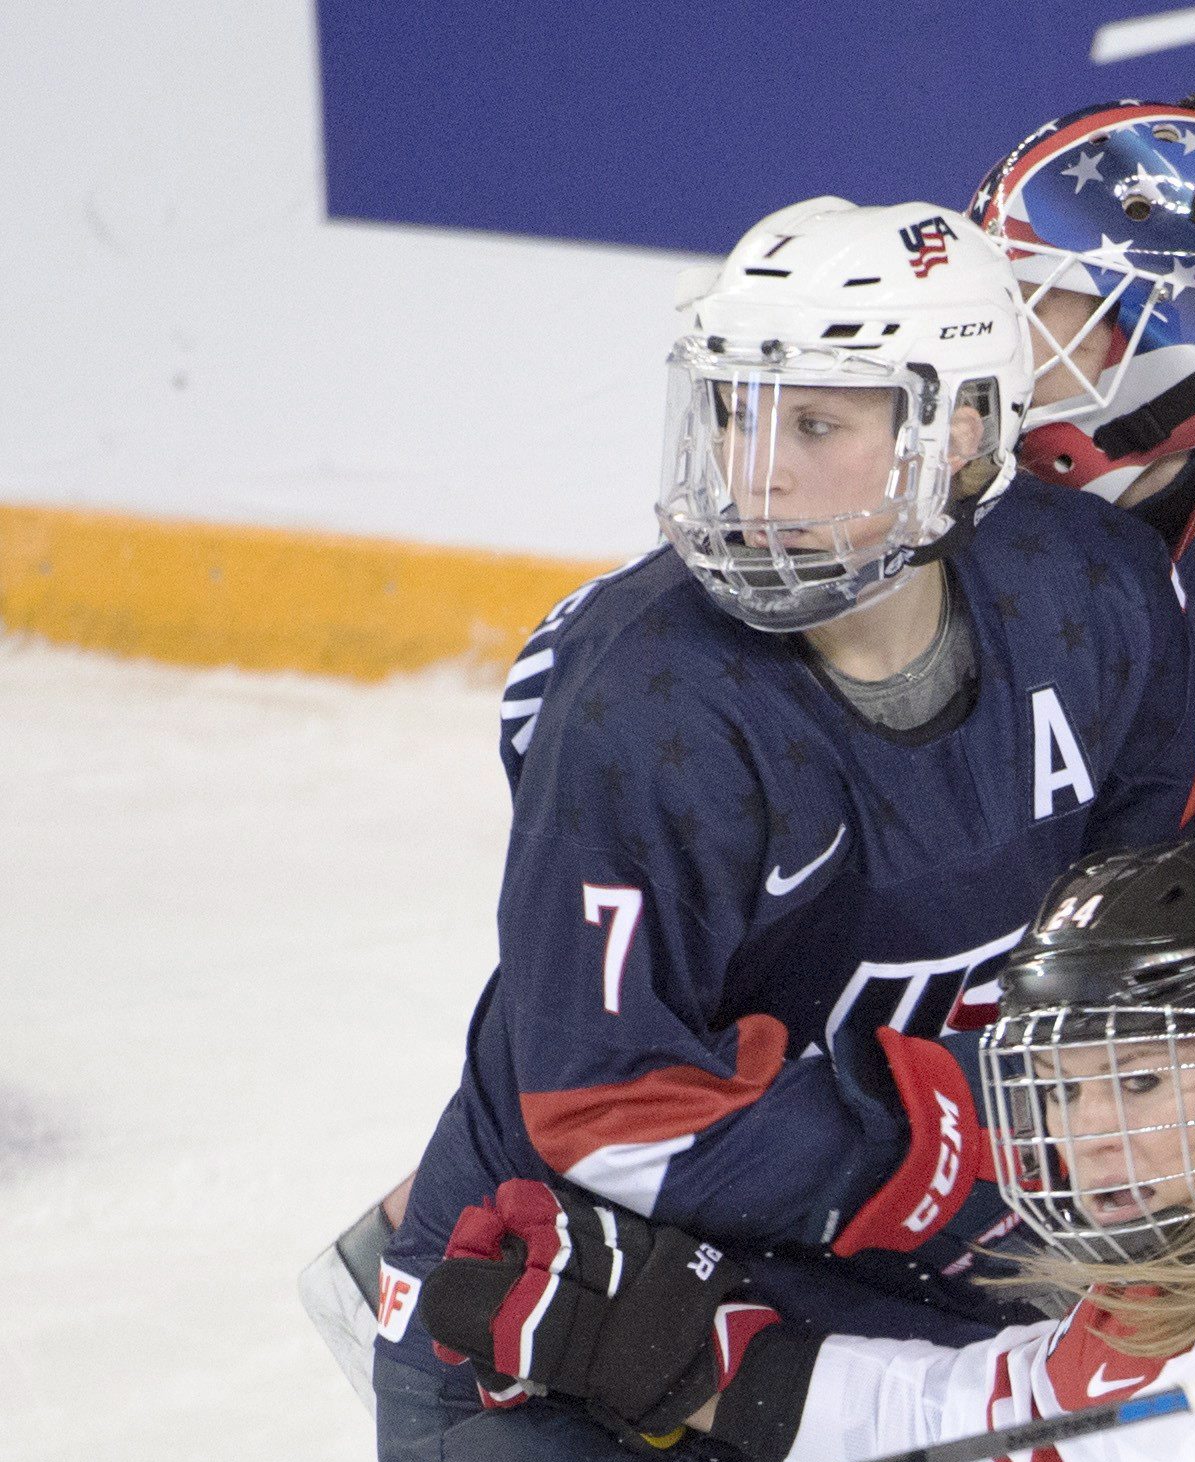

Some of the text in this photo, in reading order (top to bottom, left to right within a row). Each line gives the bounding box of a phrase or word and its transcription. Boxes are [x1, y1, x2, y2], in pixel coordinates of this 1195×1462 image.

[940, 320, 994, 340] CCM
[1032, 687, 1095, 820] A
[582, 881, 643, 1015] 7
[1045, 894, 1104, 931] 24
[902, 1088, 963, 1233] CCM
